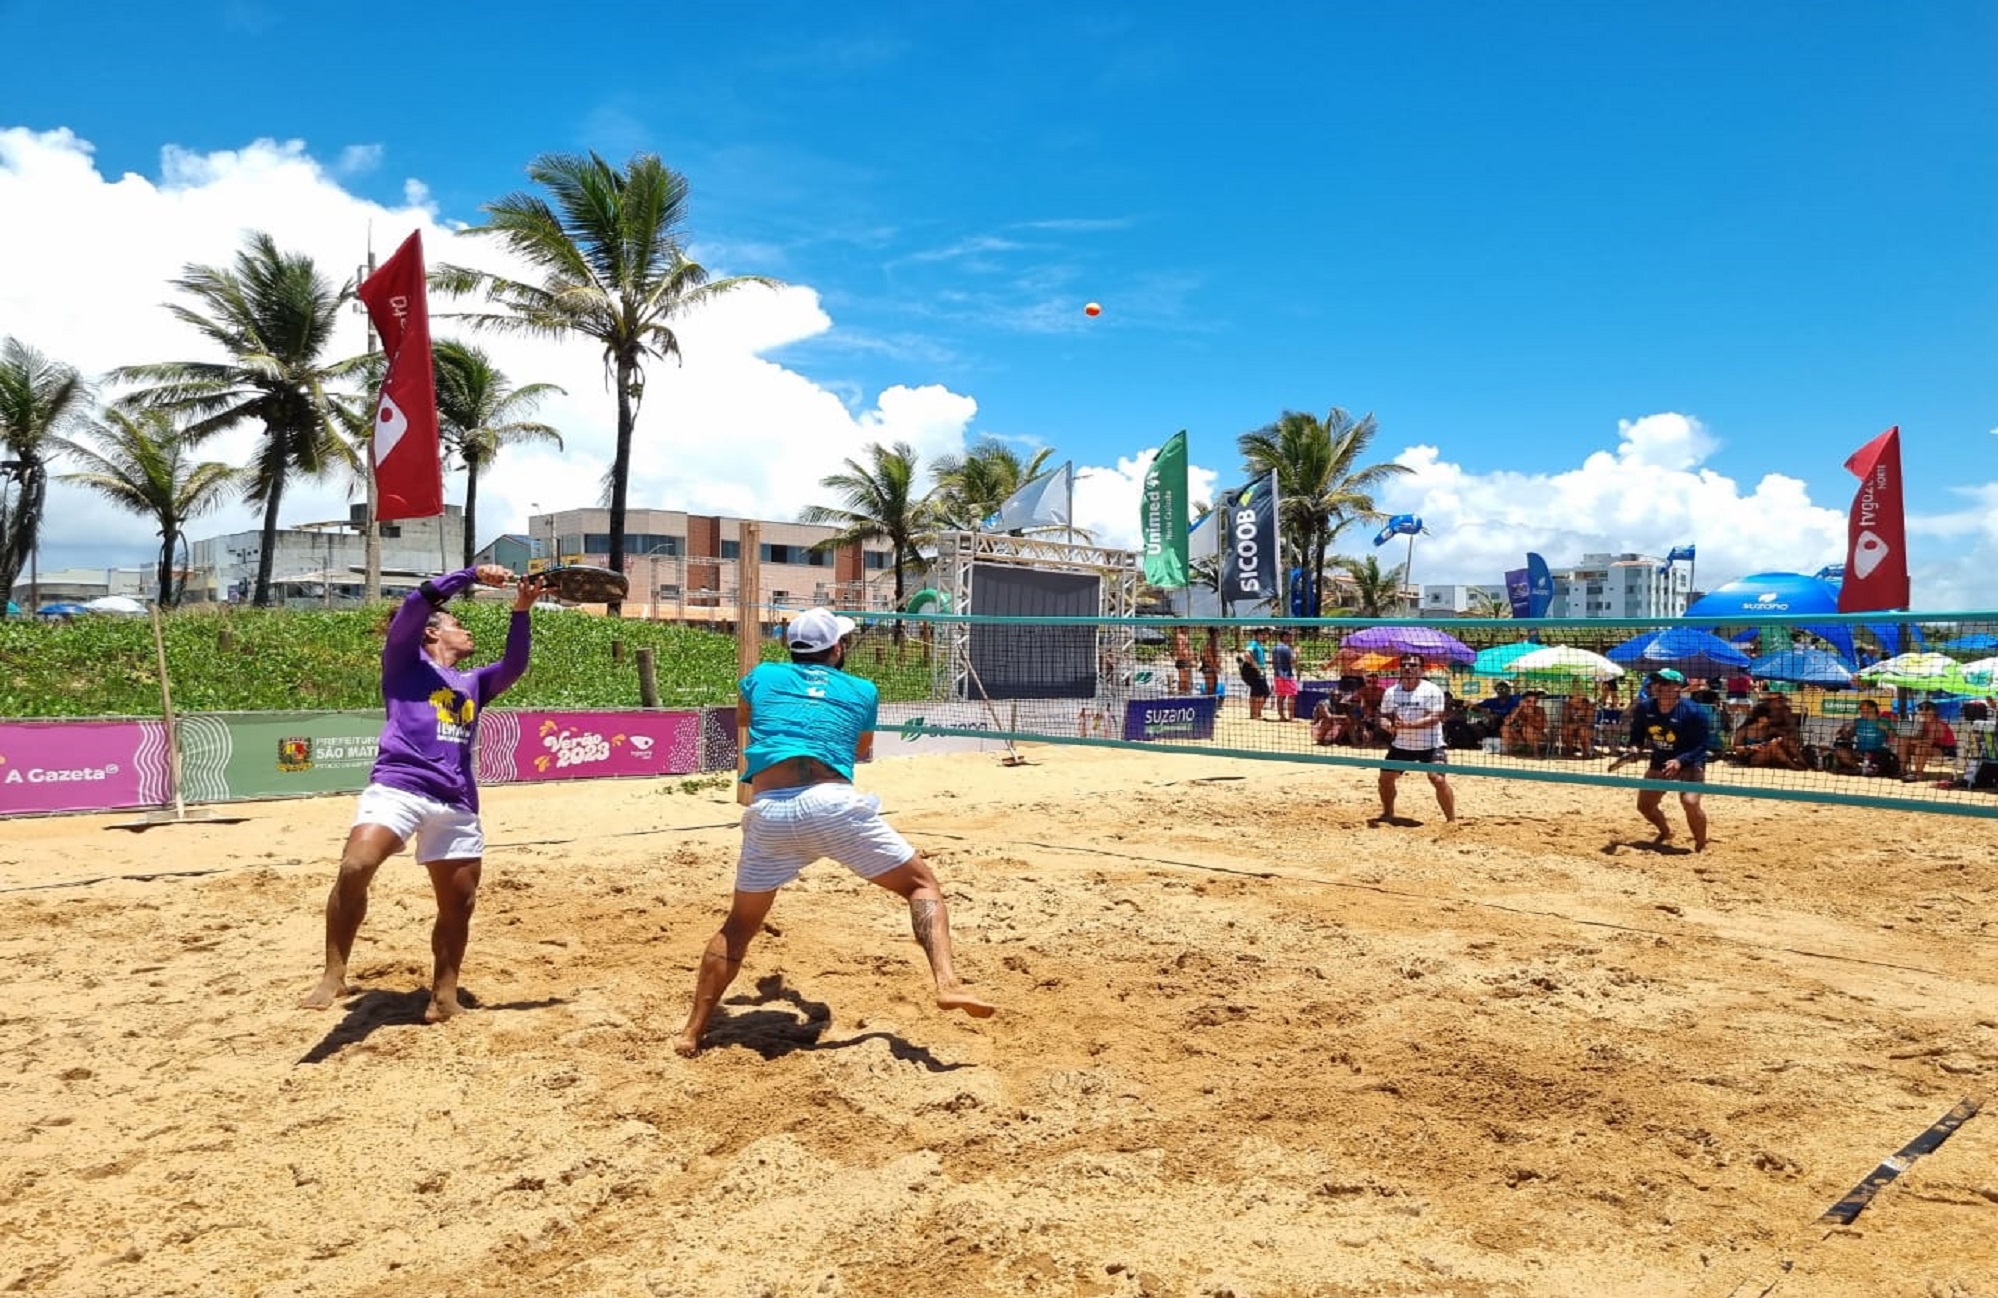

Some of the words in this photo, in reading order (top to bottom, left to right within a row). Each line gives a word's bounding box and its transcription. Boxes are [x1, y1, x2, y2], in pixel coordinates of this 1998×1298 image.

[1146, 491, 1162, 555] Unimed
[1236, 509, 1260, 592] SICOOB
[1743, 602, 1789, 611] suzano
[1144, 707, 1196, 724] suzano
[542, 730, 603, 753] Verão
[316, 746, 344, 760] SÃO
[347, 745, 380, 758] MAT
[556, 741, 610, 769] 2023
[4, 768, 24, 784] A
[27, 767, 106, 783] Gazeta
